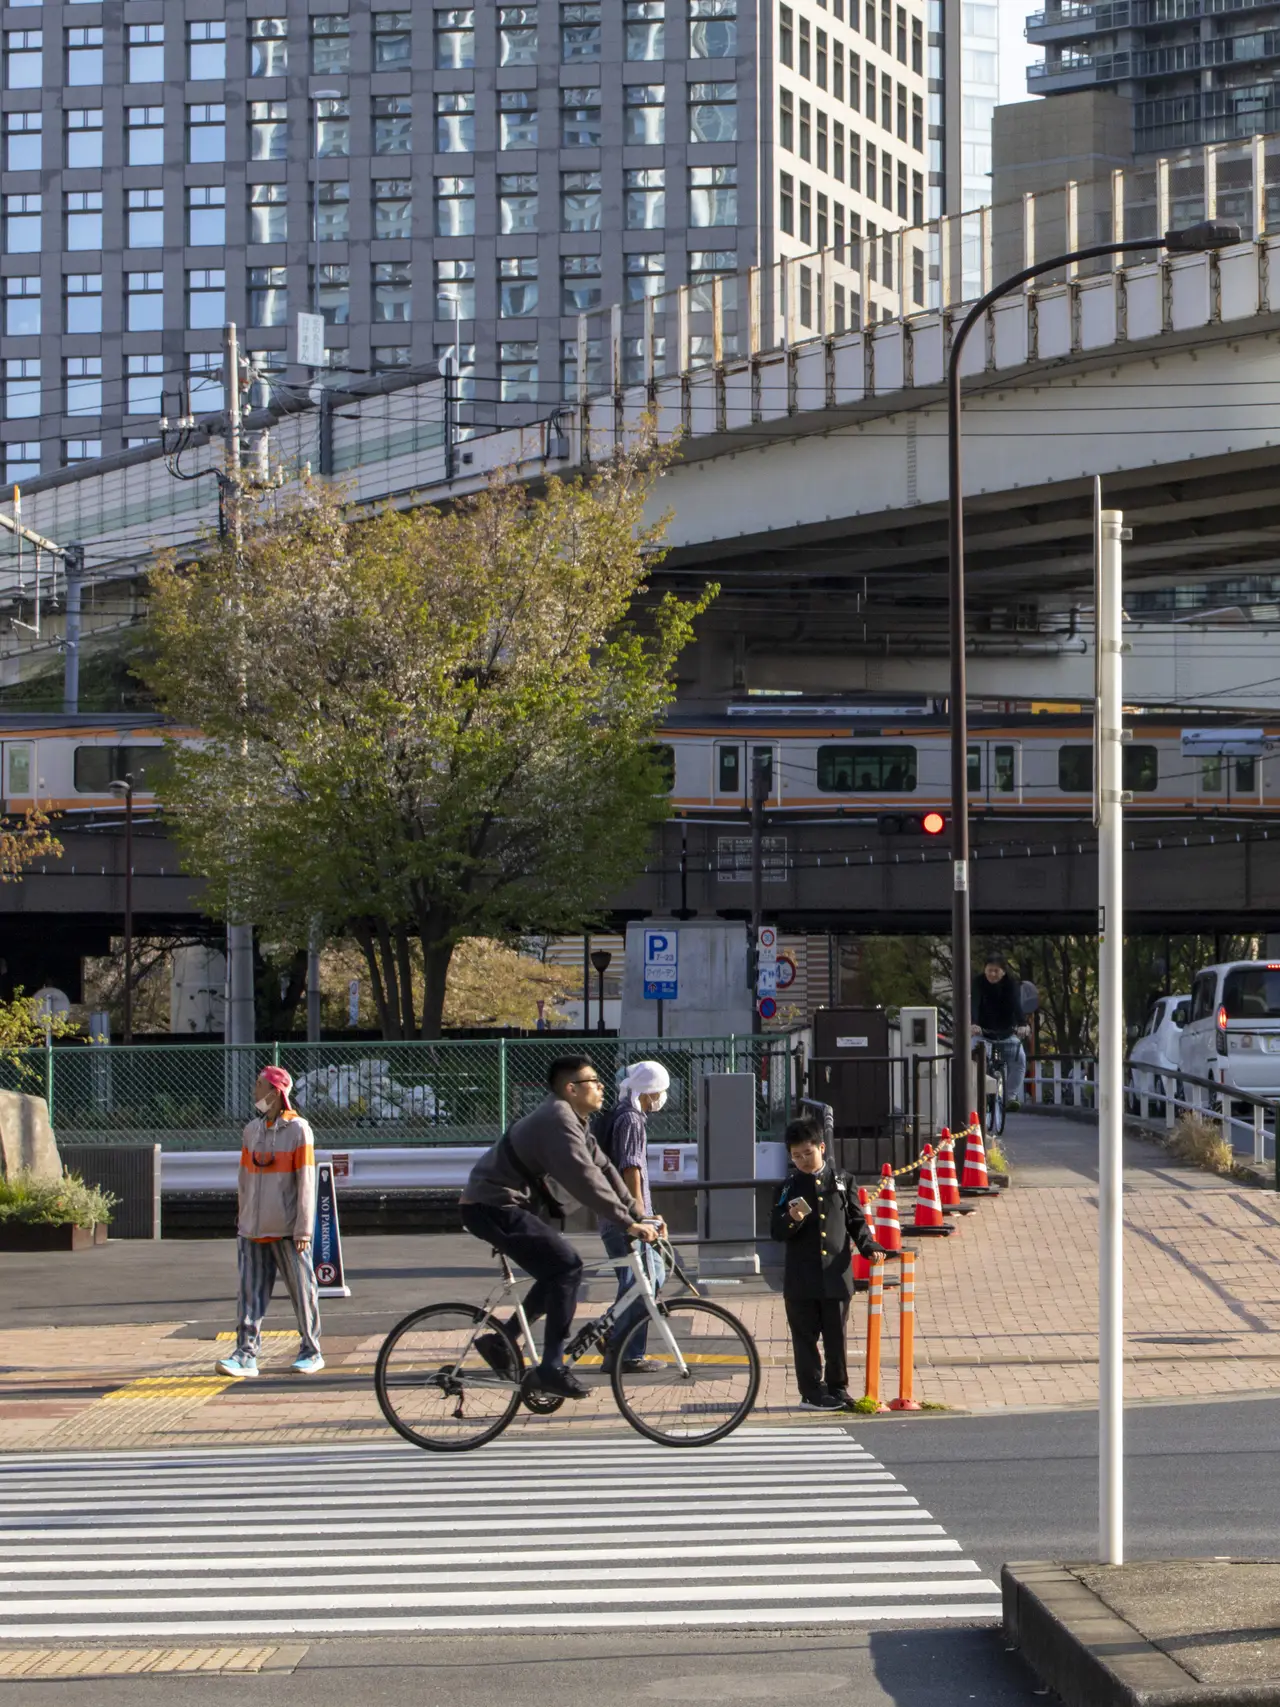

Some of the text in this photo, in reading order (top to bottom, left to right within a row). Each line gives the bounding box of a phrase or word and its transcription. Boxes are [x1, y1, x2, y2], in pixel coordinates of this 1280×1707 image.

[649, 935, 668, 960] P
[321, 1196, 331, 1260] NO PARKING
[571, 1311, 614, 1361] GIANT
